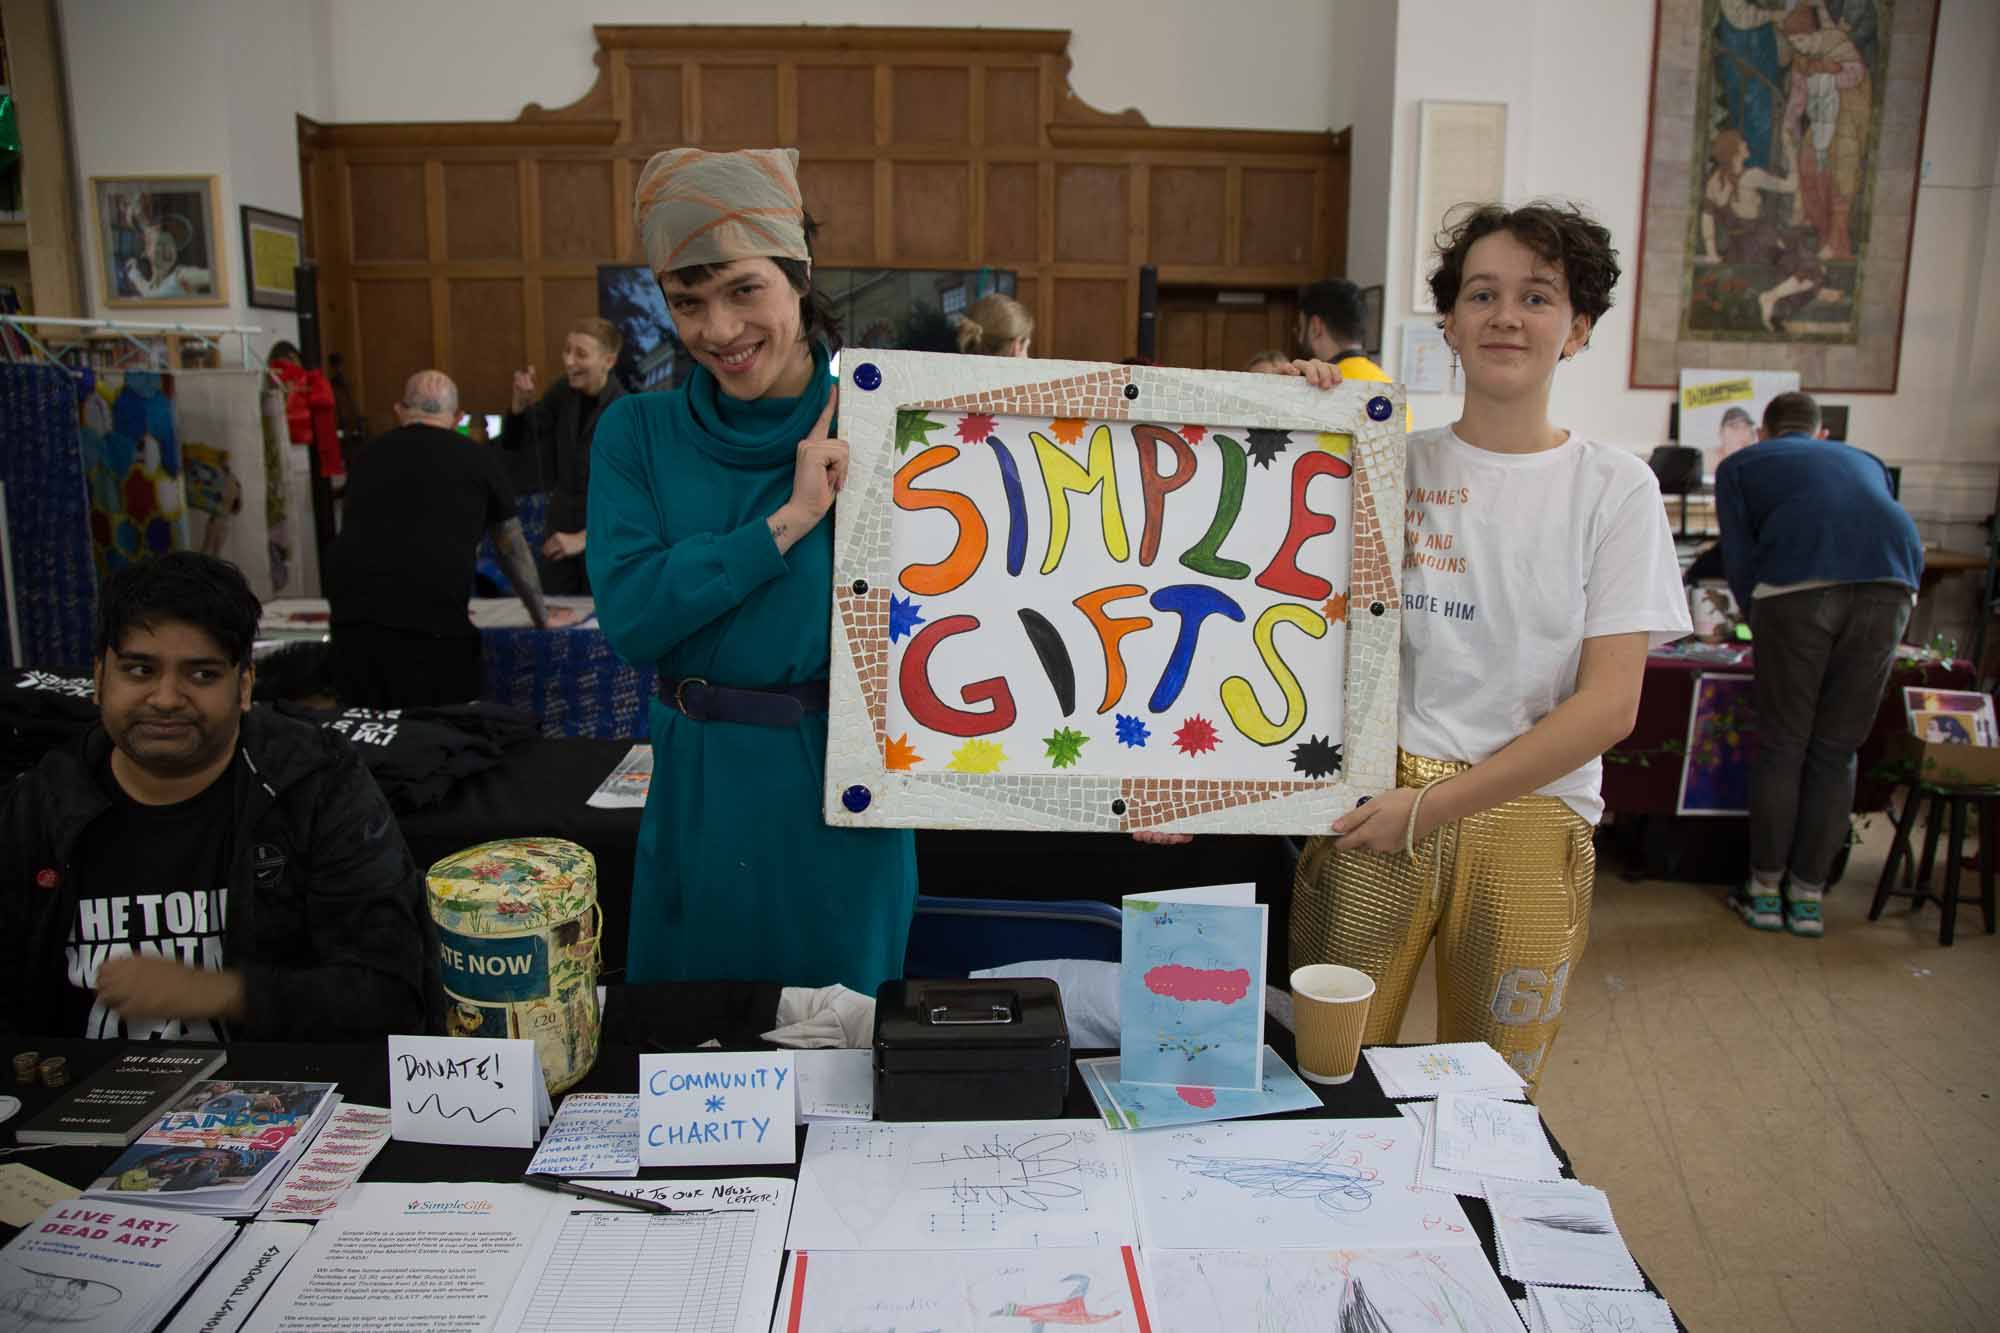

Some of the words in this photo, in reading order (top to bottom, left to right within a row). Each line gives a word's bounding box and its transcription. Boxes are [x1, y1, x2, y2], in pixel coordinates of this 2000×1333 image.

[892, 424, 1354, 600] SIMPLE
[1424, 533, 1454, 551] AND
[1443, 600, 1476, 621] HIM
[898, 584, 1328, 746] GIFTS
[468, 953, 533, 976] NOW
[534, 1012, 556, 1028] £20
[122, 1055, 148, 1065] SHY
[150, 1056, 204, 1066] RADICALS
[397, 1052, 504, 1090] DONATE!
[650, 1067, 789, 1098] COMMUNITY
[647, 1117, 771, 1147] CHARITY
[648, 1186, 673, 1200] TO
[672, 1188, 705, 1200] OUR
[55, 1208, 114, 1225] LIVE
[118, 1216, 180, 1235] ART/
[39, 1222, 109, 1241] DEAD
[113, 1233, 169, 1249] ART
